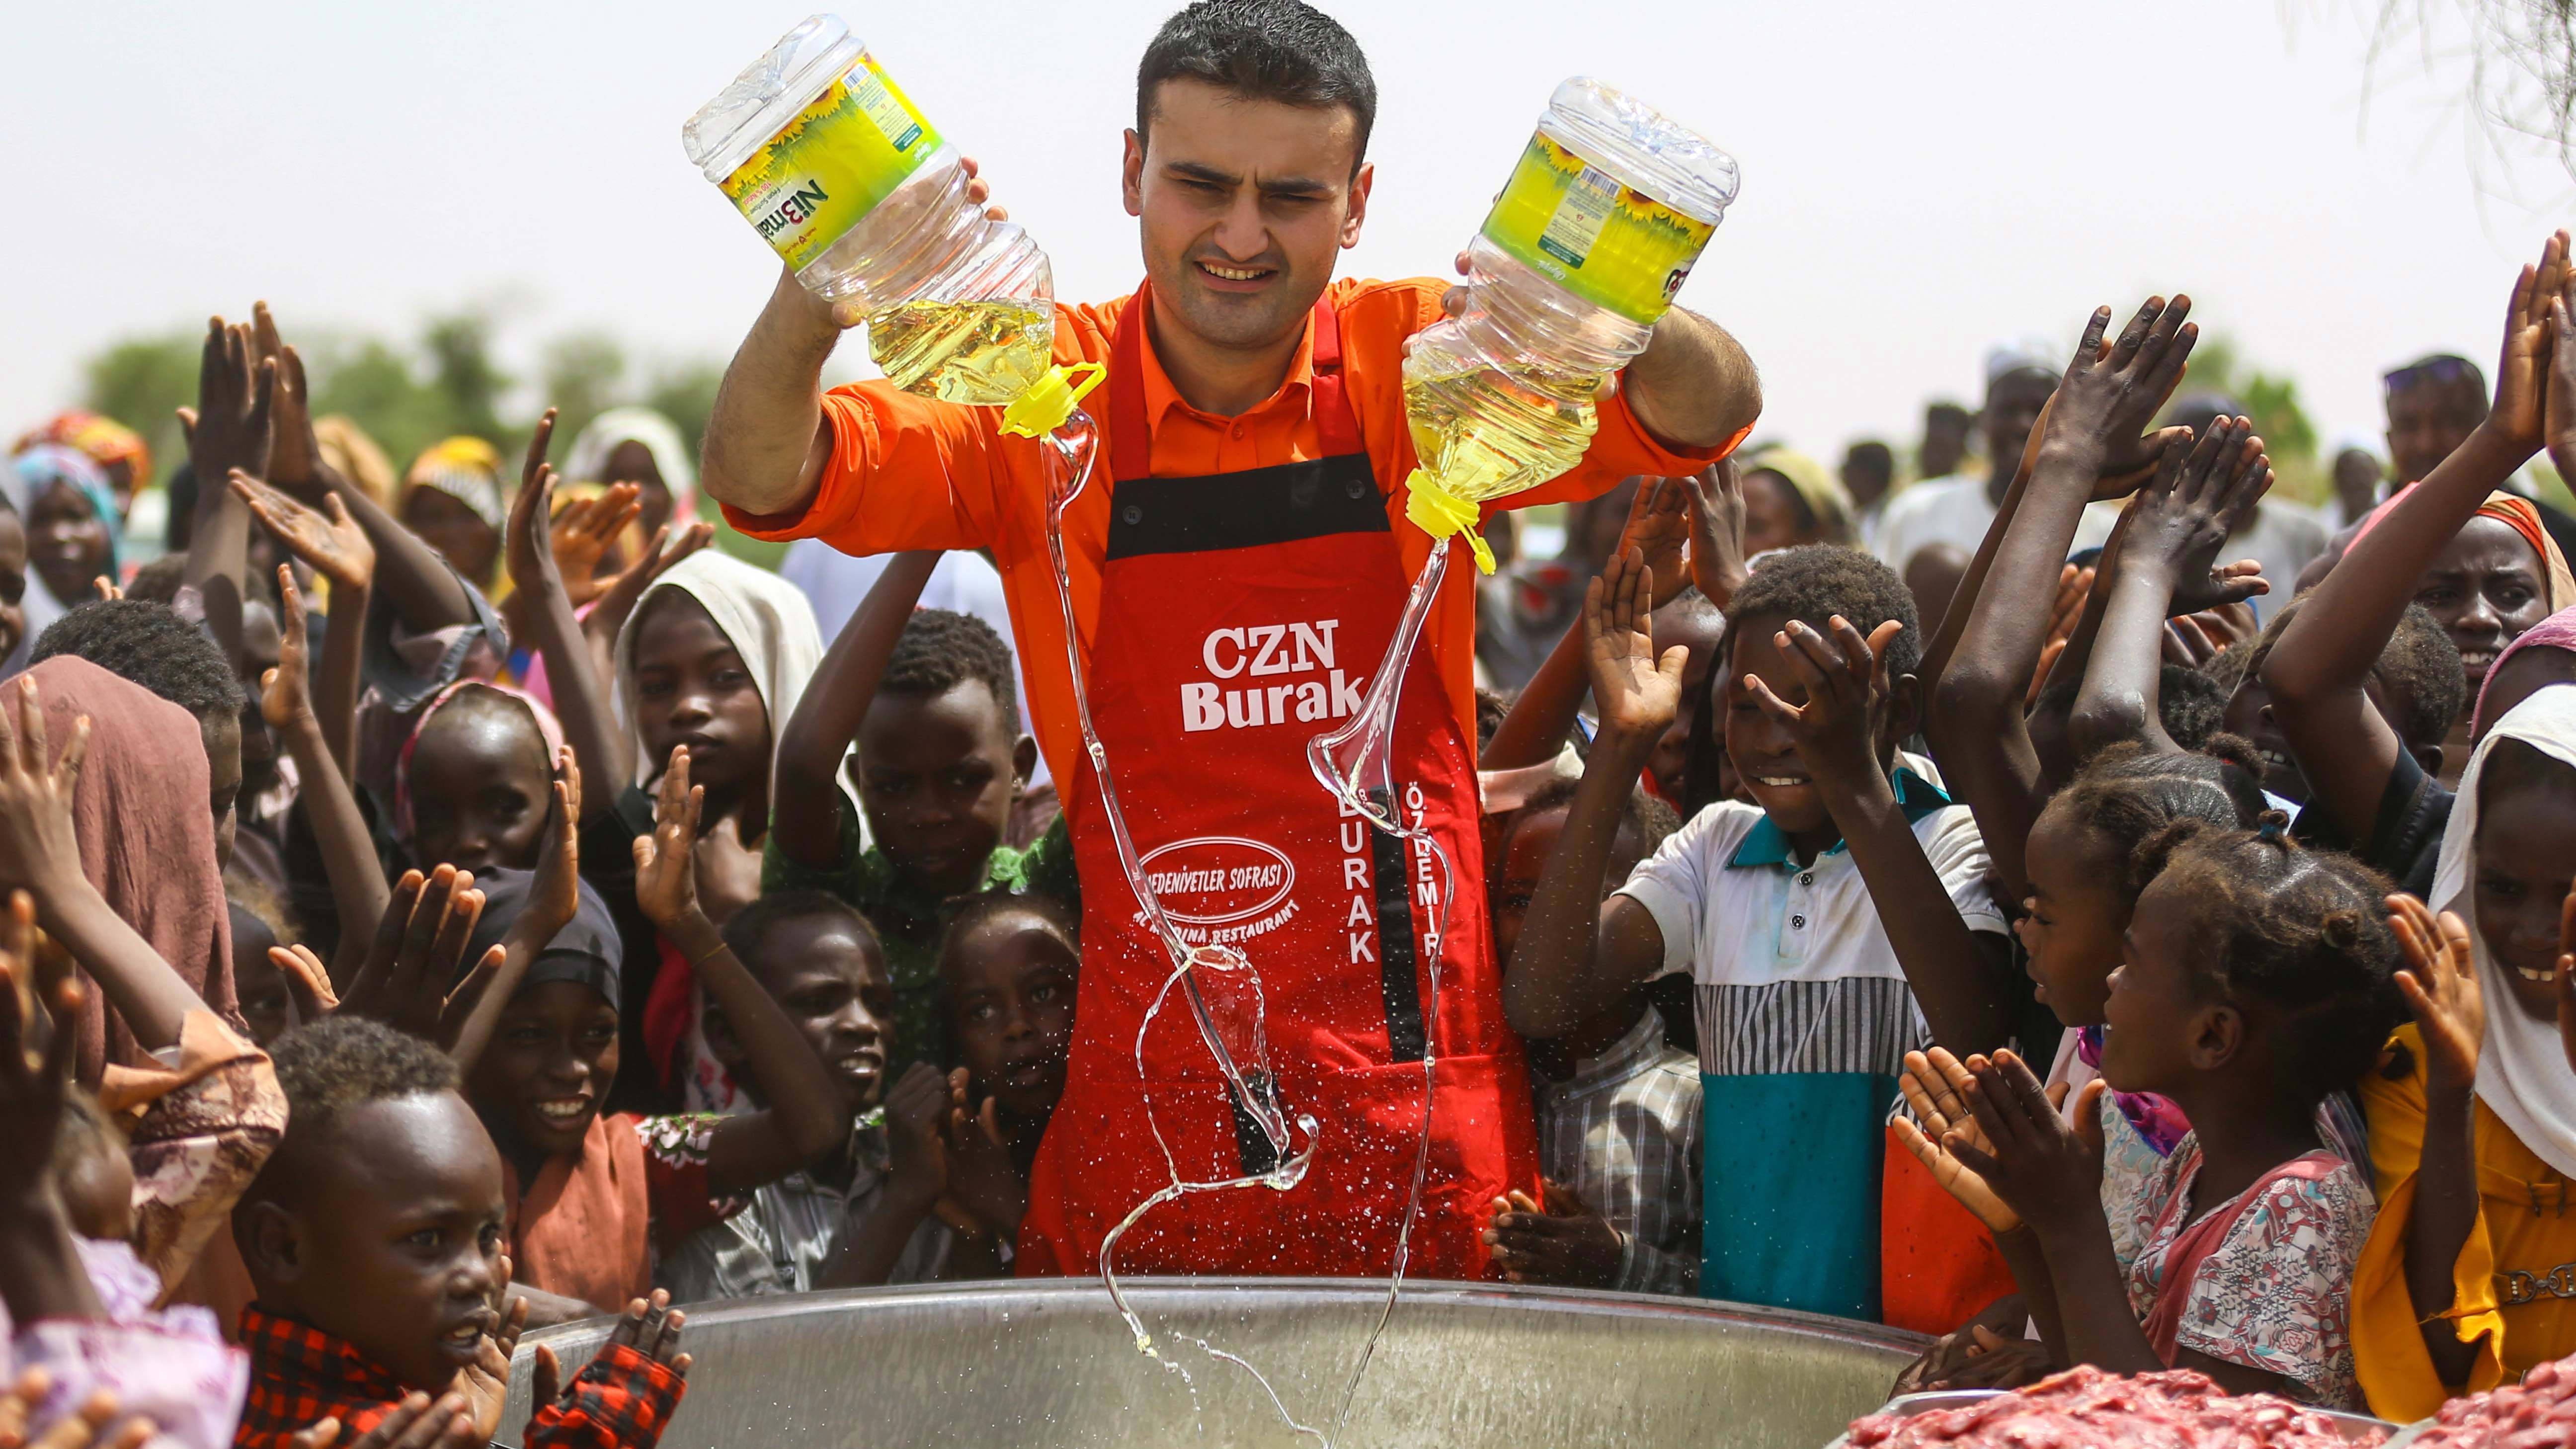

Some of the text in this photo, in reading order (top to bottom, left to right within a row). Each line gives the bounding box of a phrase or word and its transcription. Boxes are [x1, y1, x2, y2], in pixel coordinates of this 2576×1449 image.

[755, 179, 829, 245] Ni3mah
[767, 187, 781, 200] From
[1203, 619, 1339, 679] CZN
[1181, 669, 1364, 732] Burak
[1228, 864, 1282, 890] SOFRASI
[1212, 899, 1300, 945] RESTAURANT
